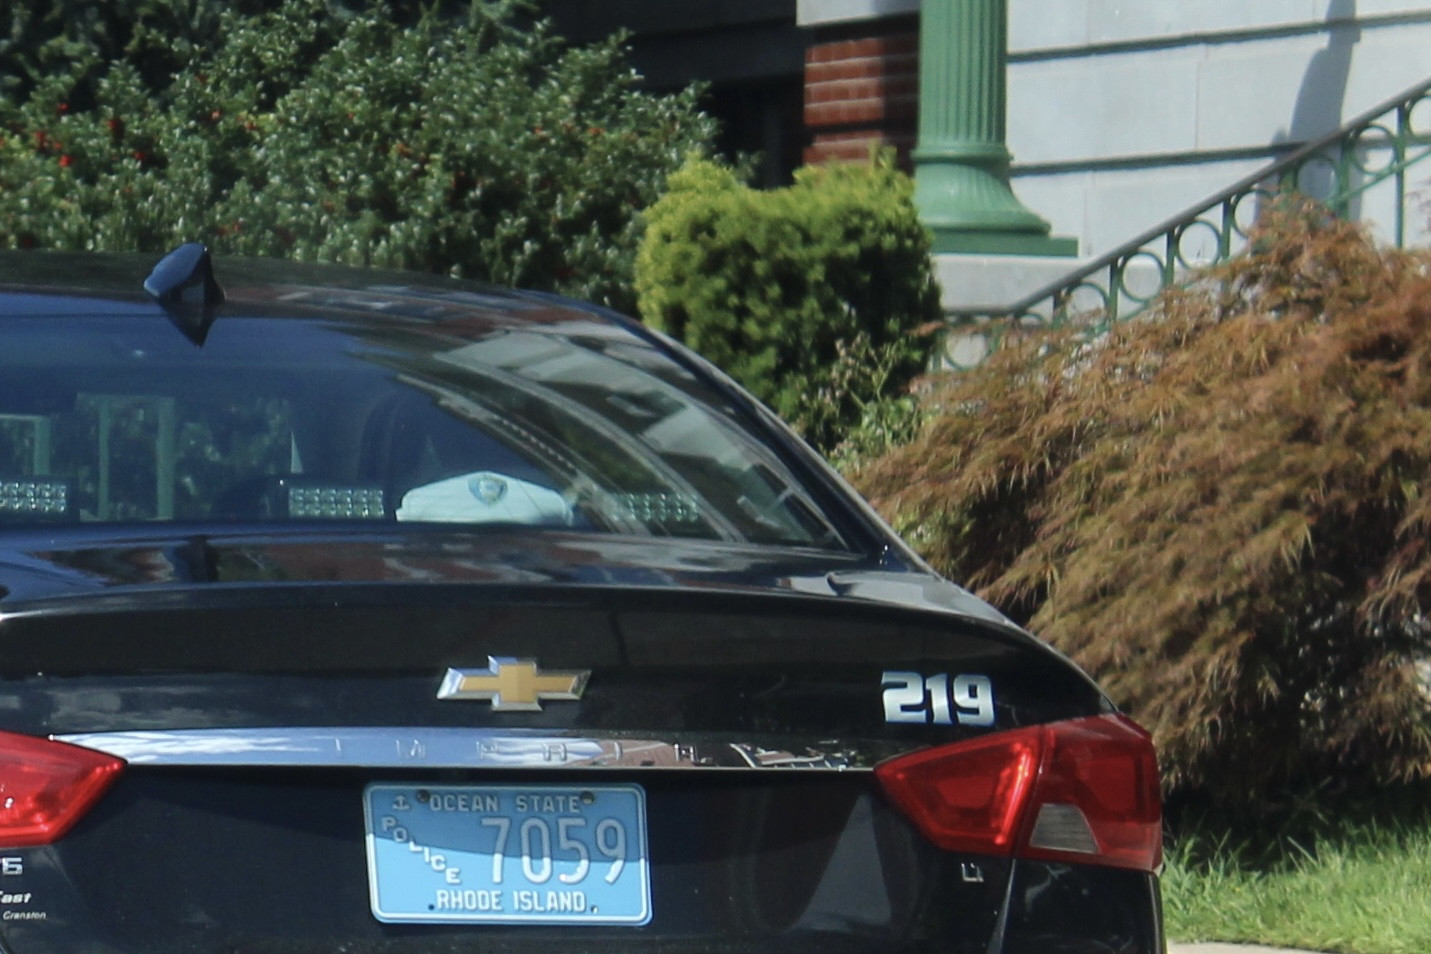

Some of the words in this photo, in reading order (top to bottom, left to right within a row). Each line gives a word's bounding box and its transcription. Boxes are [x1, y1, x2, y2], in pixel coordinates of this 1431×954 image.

[881, 670, 996, 727] 219
[429, 794, 499, 812] OCEAN
[515, 795, 580, 814] STATE
[381, 816, 462, 885] POLICE
[480, 816, 627, 885] 7059
[436, 889, 503, 911] RHODE
[513, 890, 587, 914] ISLAND
